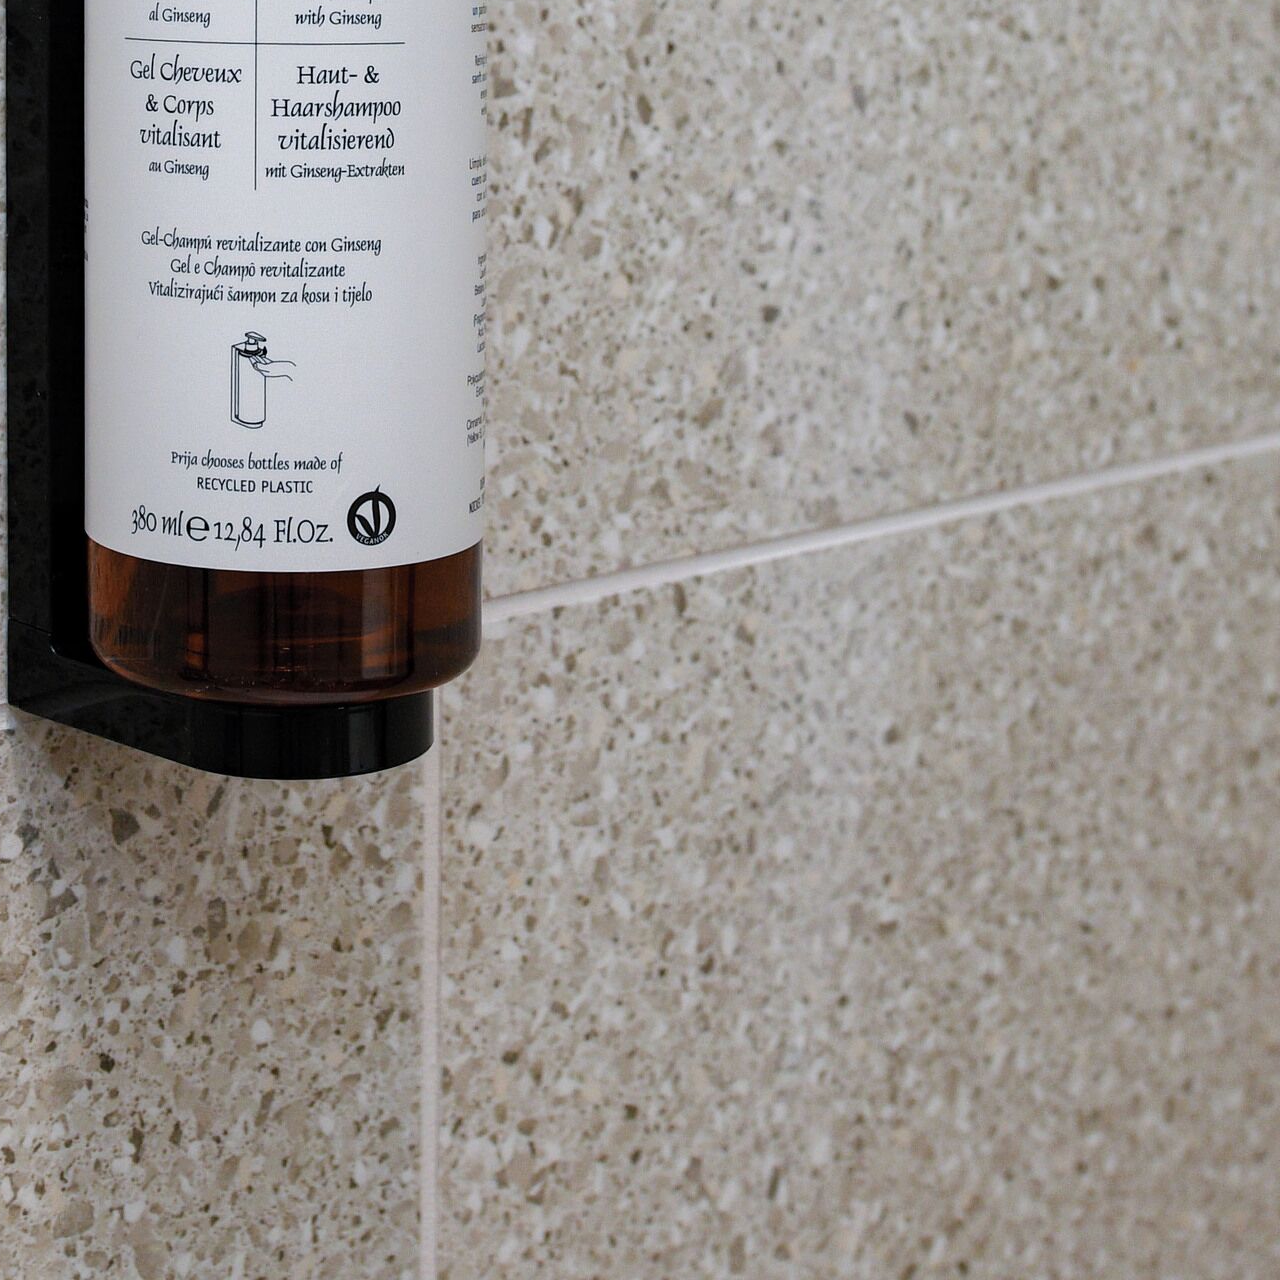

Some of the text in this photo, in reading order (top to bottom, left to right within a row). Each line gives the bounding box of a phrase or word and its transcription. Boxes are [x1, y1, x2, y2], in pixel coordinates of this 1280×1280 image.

[148, 5, 211, 29] al Ginseng
[294, 4, 382, 31] with Ginseng
[129, 52, 243, 86] Gel Cheveux
[295, 64, 381, 85] Haut- &
[145, 93, 215, 123] & Corps
[270, 89, 402, 124] Haarshampoo
[139, 118, 222, 149] vitalisant
[277, 122, 395, 151] vitalisierend
[148, 158, 210, 182] au Ginseng
[264, 156, 406, 183] mit Ginseng-Extrakten
[215, 231, 302, 253] revitalizante
[304, 240, 328, 253] con
[330, 237, 382, 257] Ginseng
[169, 256, 192, 274] Gel
[193, 262, 201, 275] e
[259, 256, 346, 279] revitalizante
[280, 291, 299, 304] za
[301, 285, 331, 306] kosu
[333, 291, 339, 304] i
[342, 280, 373, 307] tijelo
[170, 449, 344, 475] Prija chooses bottles made of
[196, 476, 314, 494] RECYCLED PLASTIC
[130, 504, 158, 535] 380
[161, 509, 185, 537] ml
[213, 515, 267, 550] 12,84
[272, 515, 334, 544] Fl.Oz.
[356, 531, 389, 545] VEGANOK
